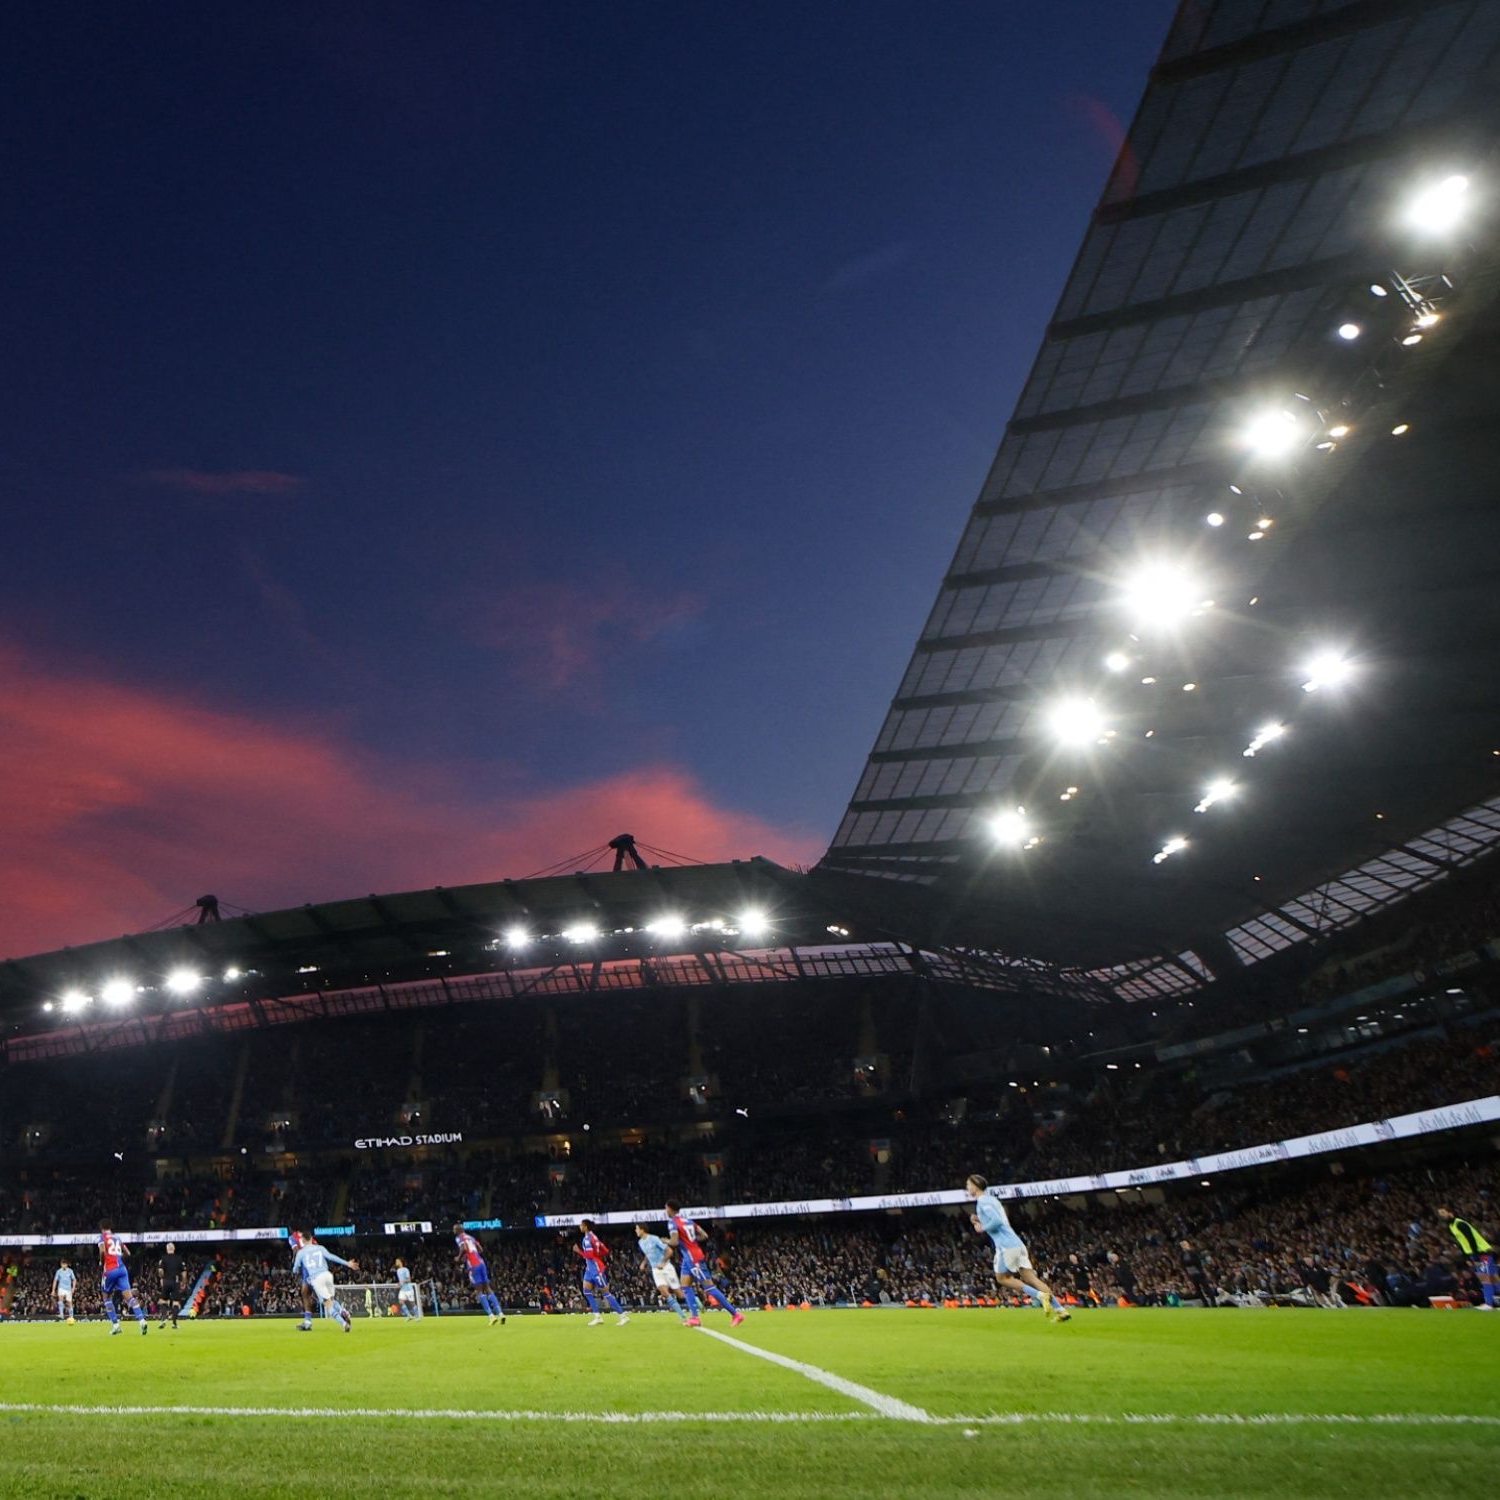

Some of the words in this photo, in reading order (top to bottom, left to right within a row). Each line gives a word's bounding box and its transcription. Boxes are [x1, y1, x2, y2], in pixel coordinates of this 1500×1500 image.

[354, 1136, 413, 1149] ETIHAD
[415, 1132, 463, 1145] STADIUM
[107, 1238, 122, 1256] 26
[304, 1250, 323, 1267] 47
